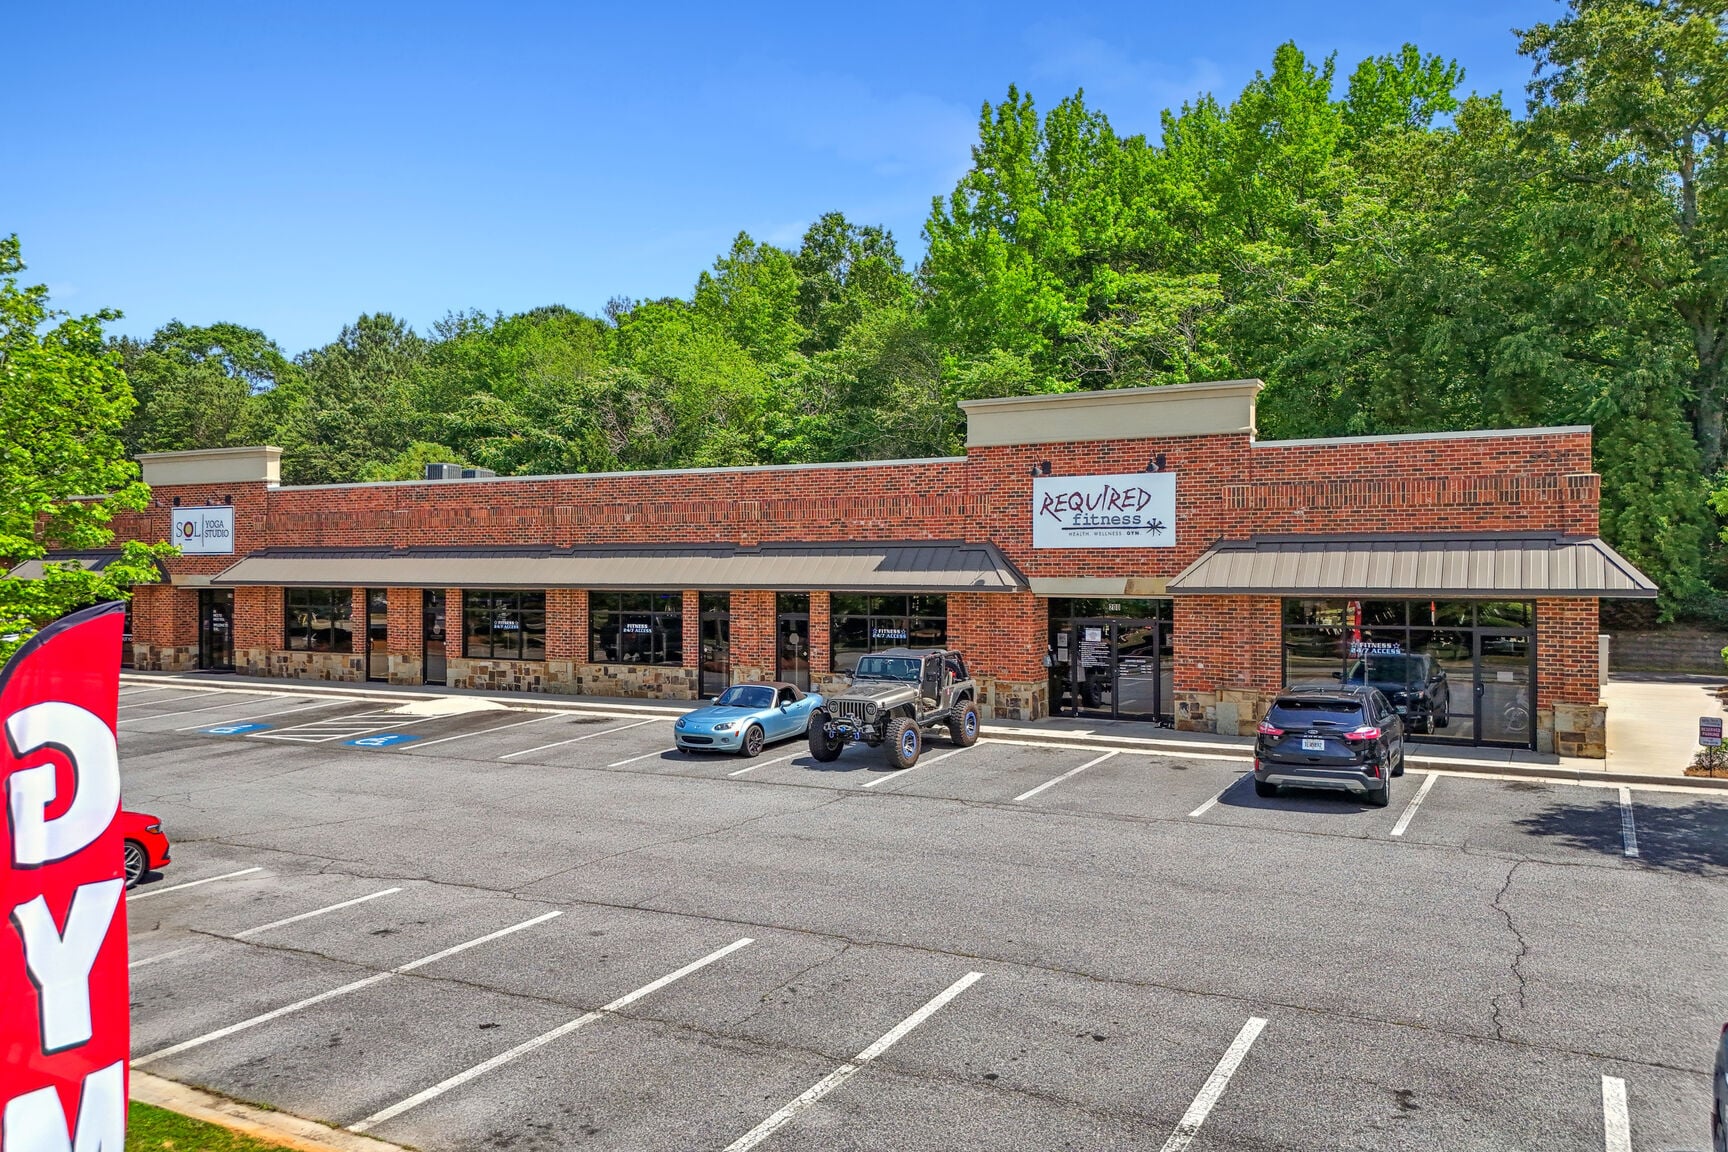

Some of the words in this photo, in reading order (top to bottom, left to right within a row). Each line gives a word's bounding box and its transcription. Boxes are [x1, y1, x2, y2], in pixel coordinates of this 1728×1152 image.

[1040, 484, 1152, 522] REQUIRED
[205, 520, 225, 529] YOGA
[1072, 513, 1142, 526] fitness
[176, 521, 201, 538] SOL
[204, 529, 229, 538] STUDIO
